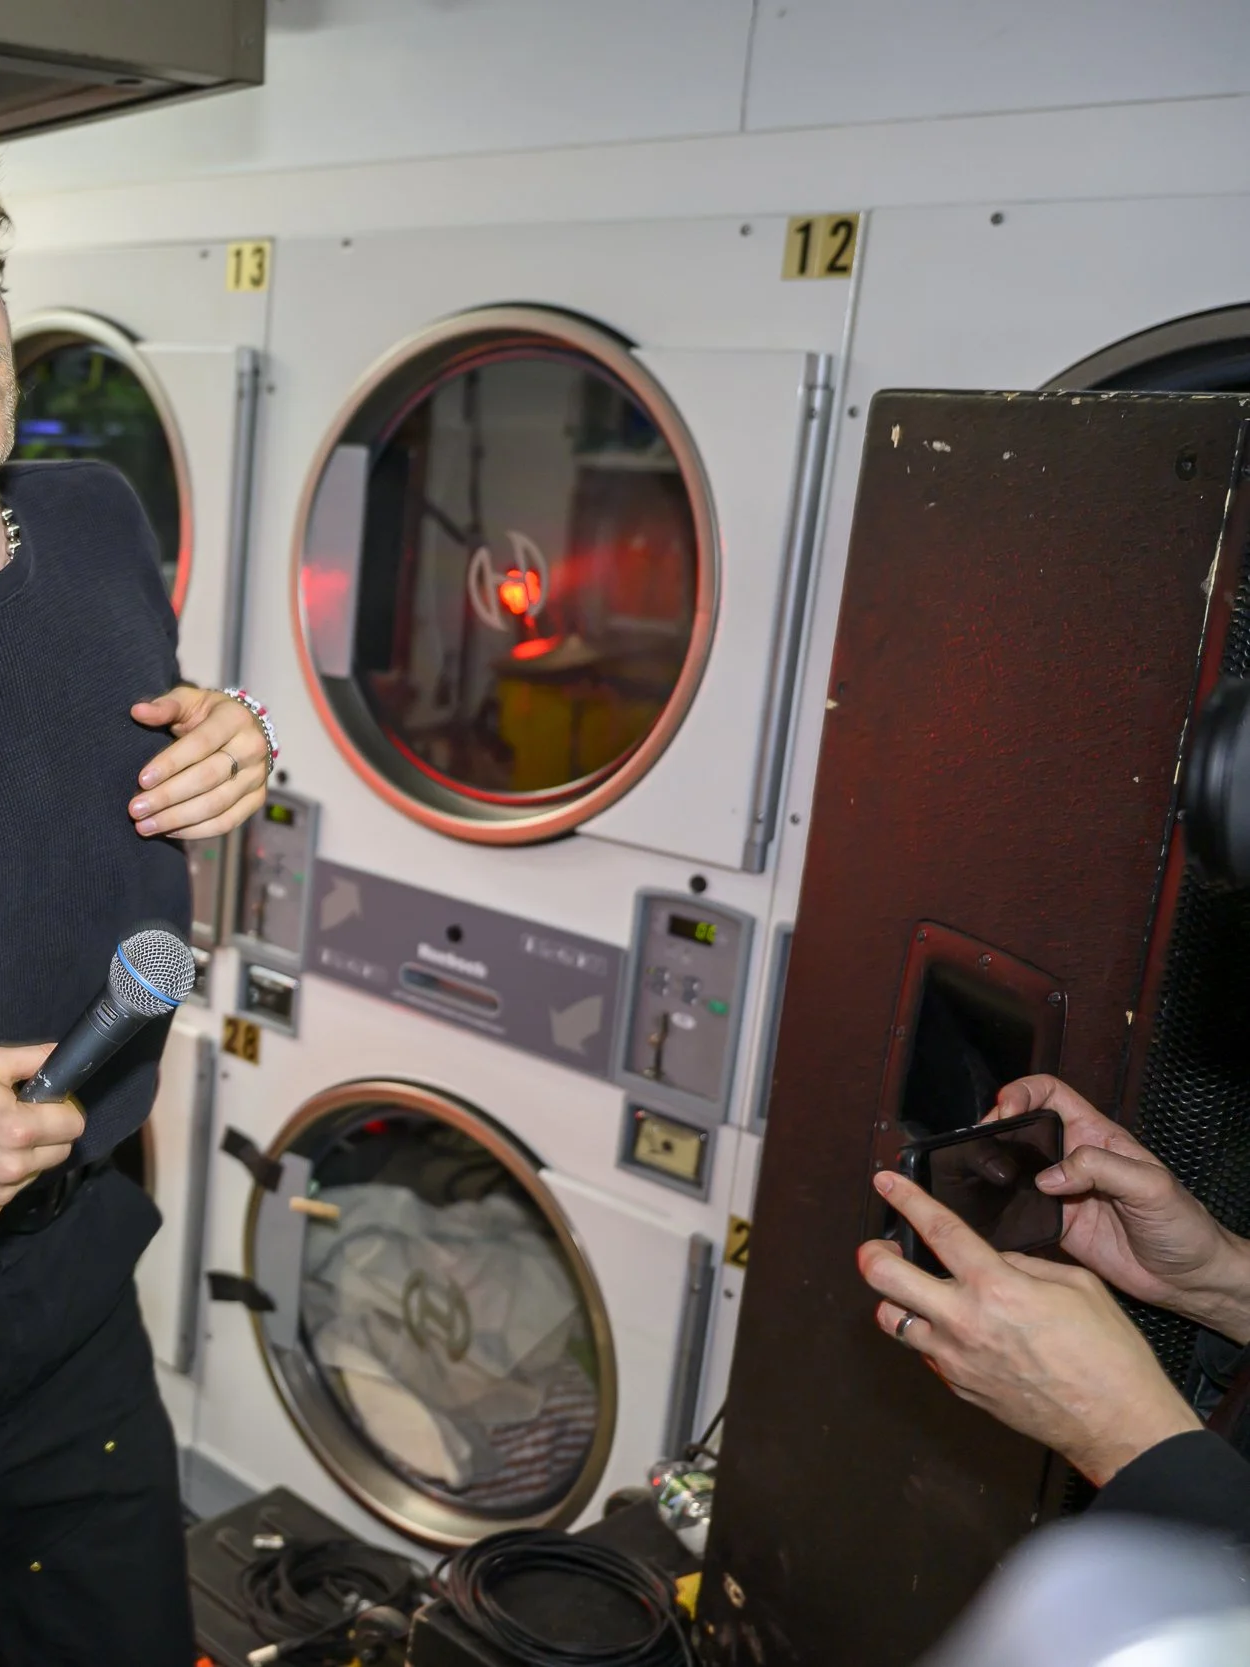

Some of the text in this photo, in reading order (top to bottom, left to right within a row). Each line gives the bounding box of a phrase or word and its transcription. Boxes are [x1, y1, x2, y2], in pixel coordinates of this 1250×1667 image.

[233, 246, 266, 289] 13
[794, 218, 854, 275] 12
[223, 1017, 258, 1061] 28
